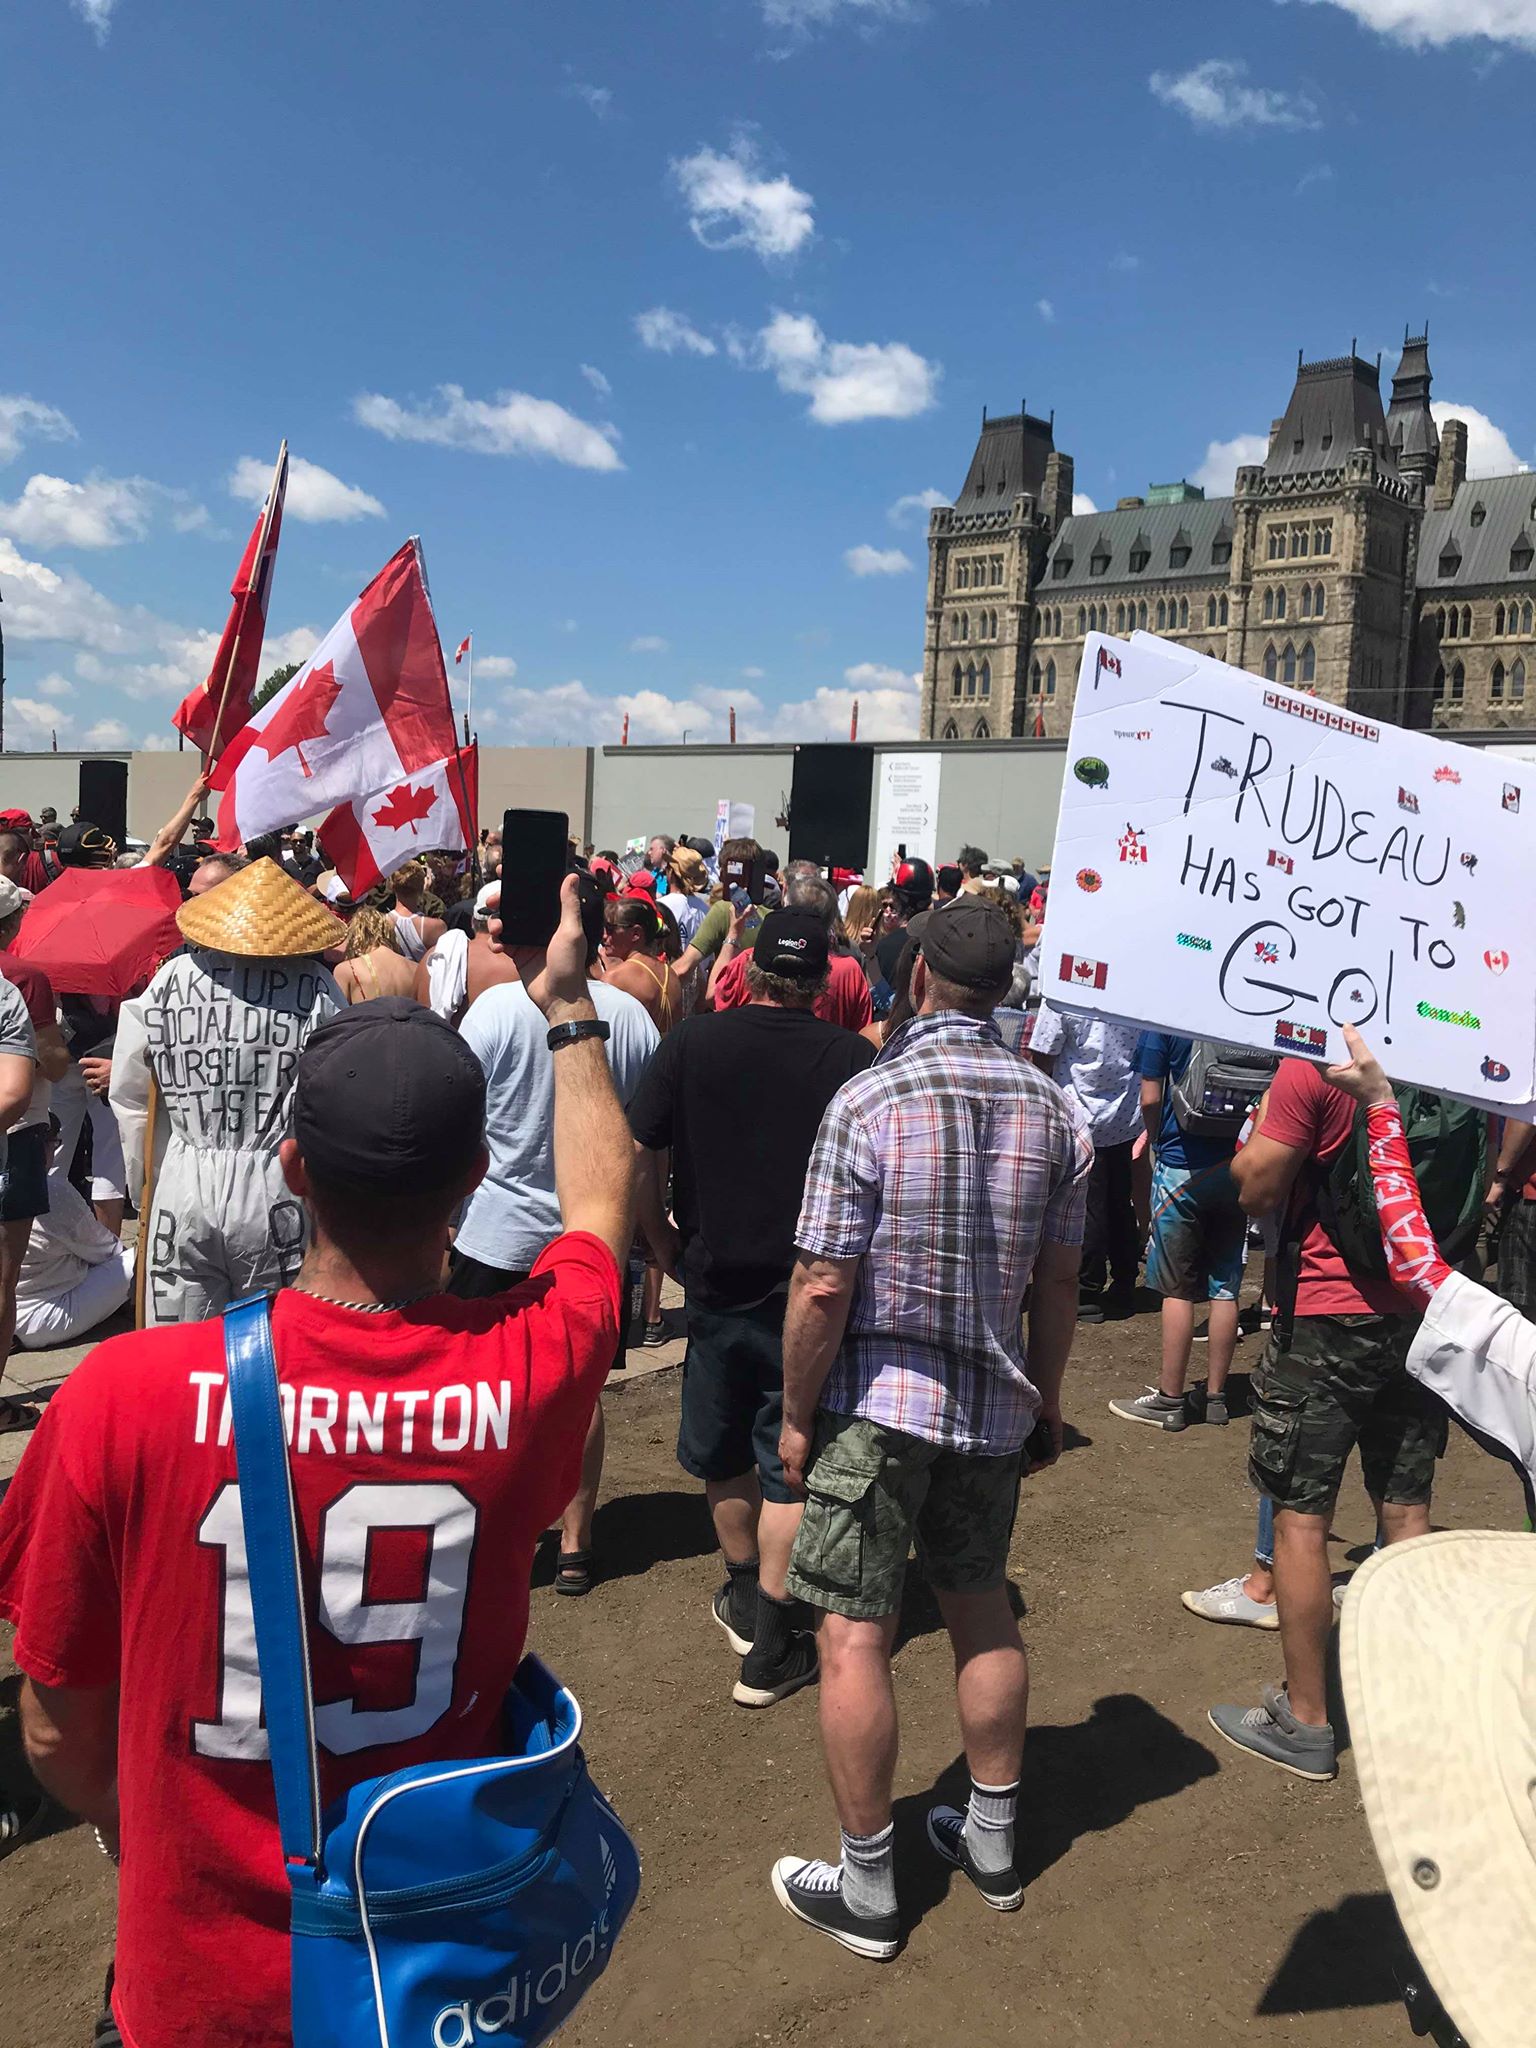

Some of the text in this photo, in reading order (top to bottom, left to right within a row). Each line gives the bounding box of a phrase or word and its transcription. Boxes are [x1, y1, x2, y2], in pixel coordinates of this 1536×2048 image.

[1160, 701, 1451, 885] TRUDEAU
[1180, 835, 1456, 969] HAS GOT TO
[145, 1005, 239, 1049] SOCIAL
[243, 968, 289, 1004] UP
[1219, 920, 1394, 1045] GO!
[153, 1047, 272, 1089] OURSELF
[189, 1371, 511, 1454] TRNTON
[192, 1484, 477, 1760] 19
